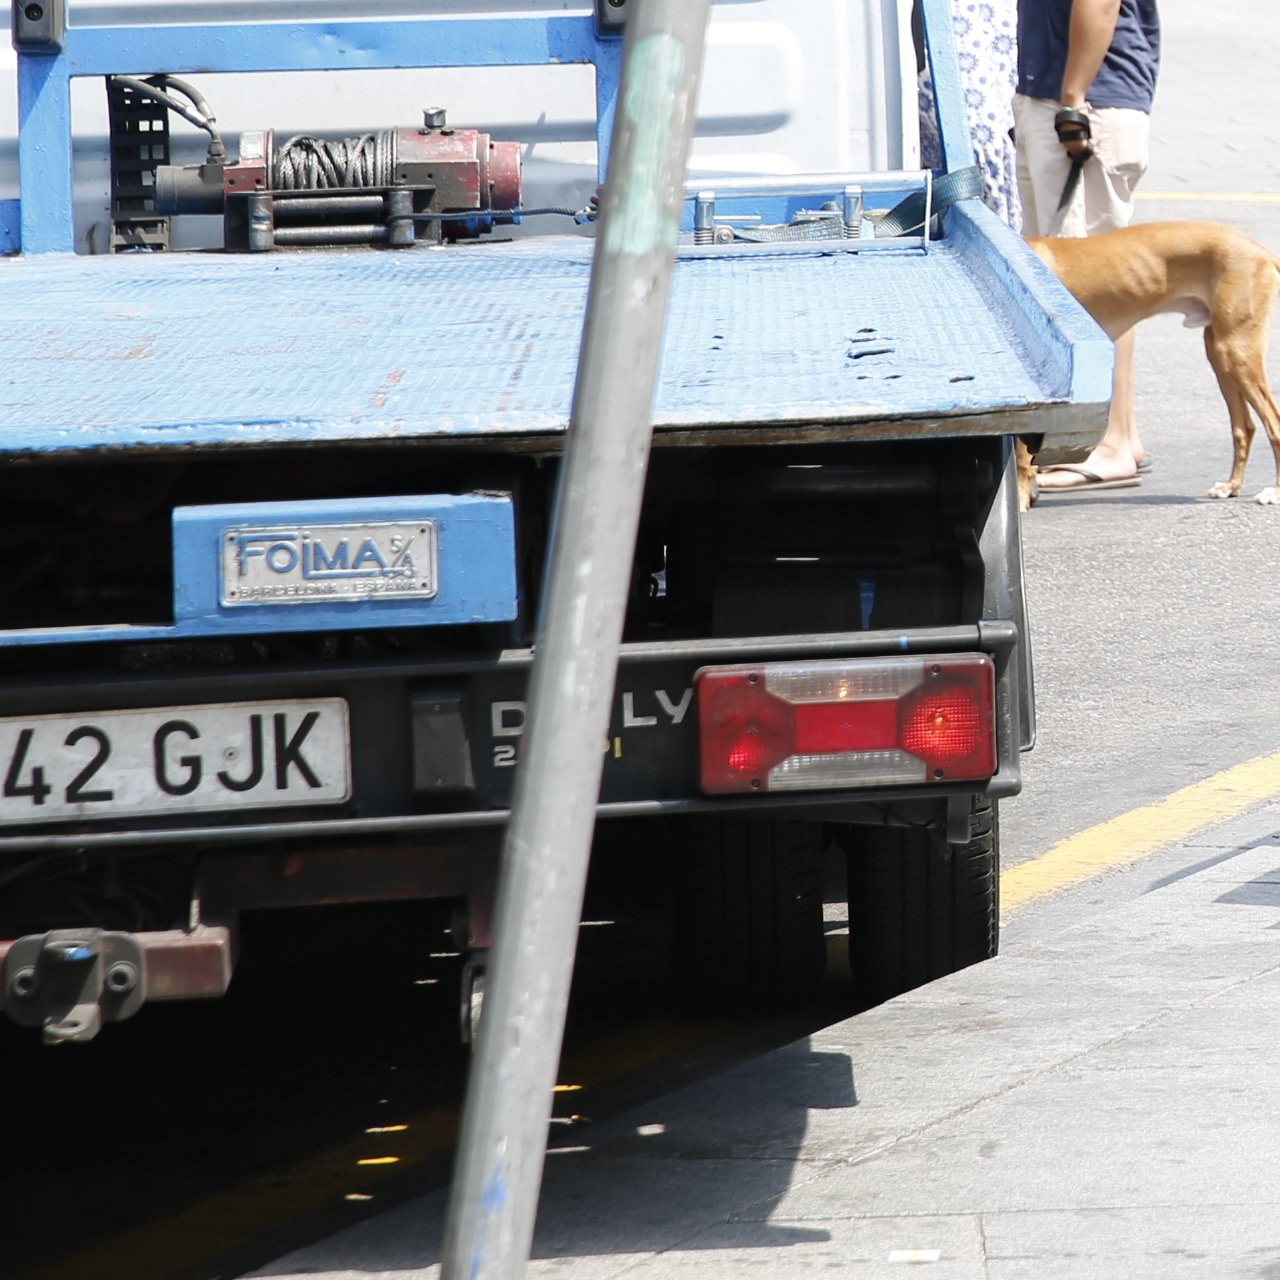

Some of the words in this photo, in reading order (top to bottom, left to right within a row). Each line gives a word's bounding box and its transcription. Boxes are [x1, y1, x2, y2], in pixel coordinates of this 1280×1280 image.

[240, 582, 337, 598] BARCELONA
[491, 688, 694, 738] DLY
[153, 711, 324, 798] GJK
